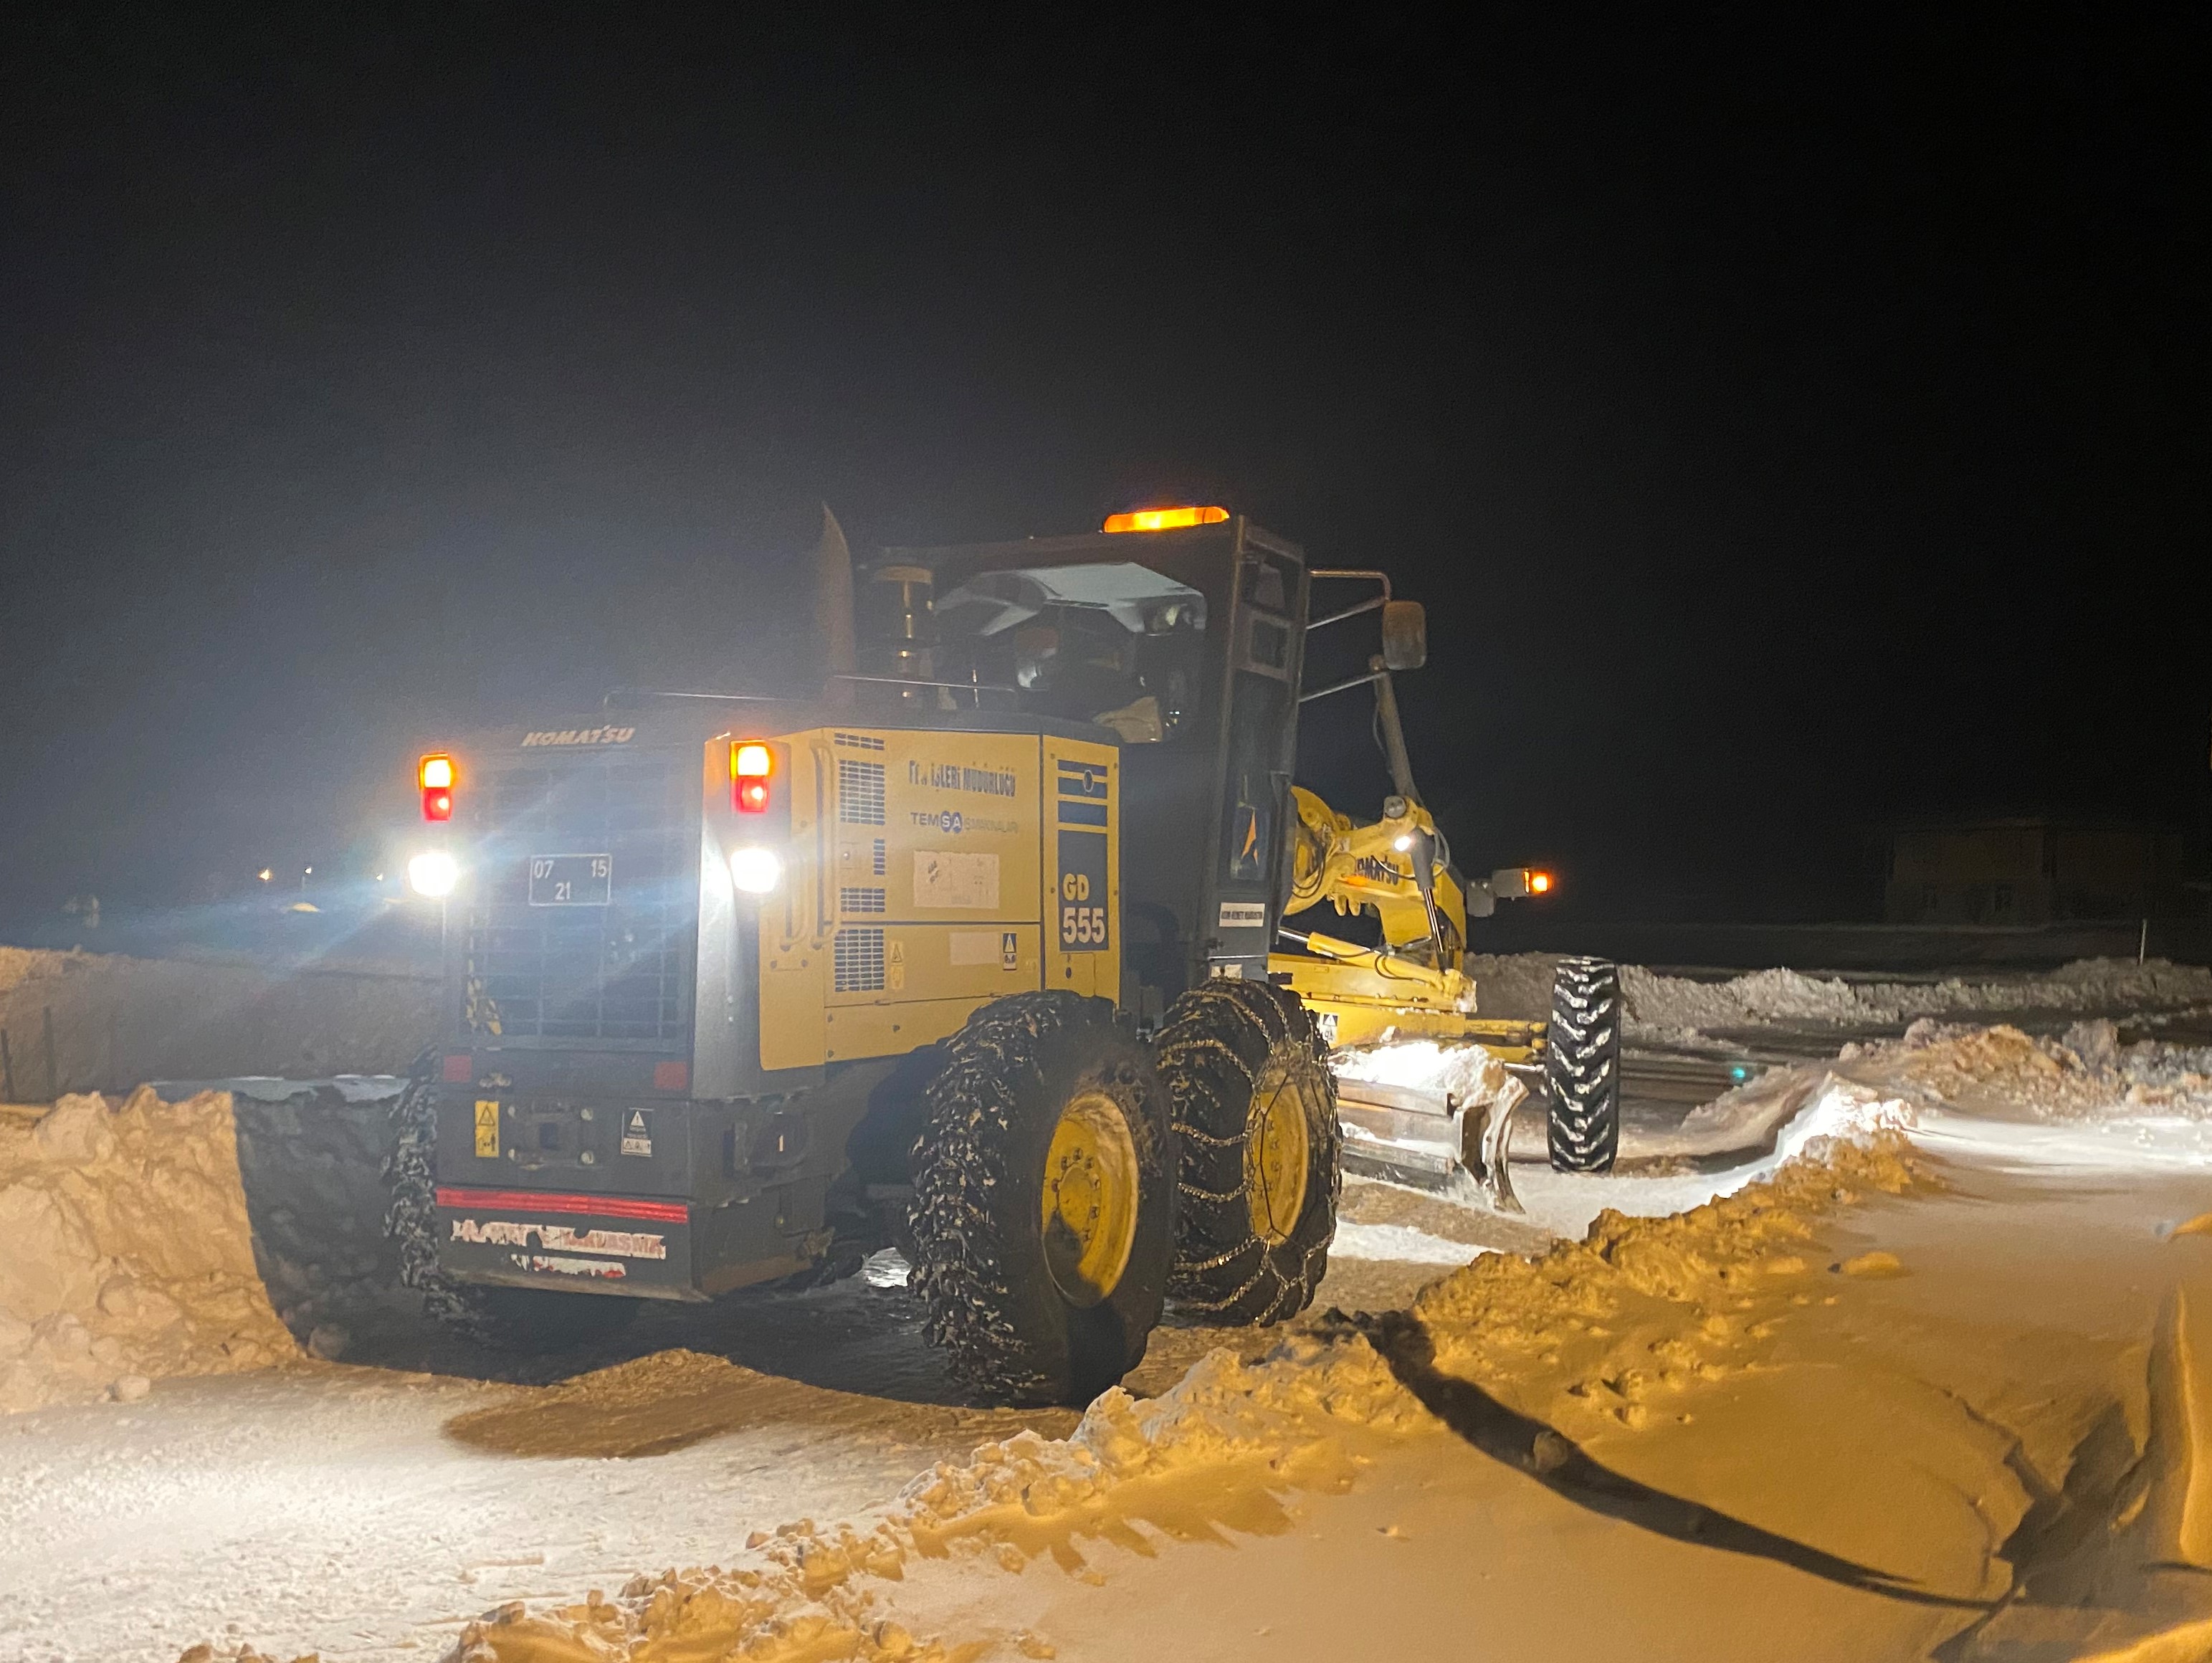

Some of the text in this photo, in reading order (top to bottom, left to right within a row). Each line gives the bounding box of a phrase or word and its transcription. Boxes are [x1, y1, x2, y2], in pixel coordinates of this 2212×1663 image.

[522, 725, 635, 746] KOMATSU
[910, 811, 963, 834] TEMSA
[534, 859, 607, 879] 07 15
[555, 882, 571, 900] 21
[1063, 873, 1089, 901] GD
[1063, 907, 1105, 943] 555
